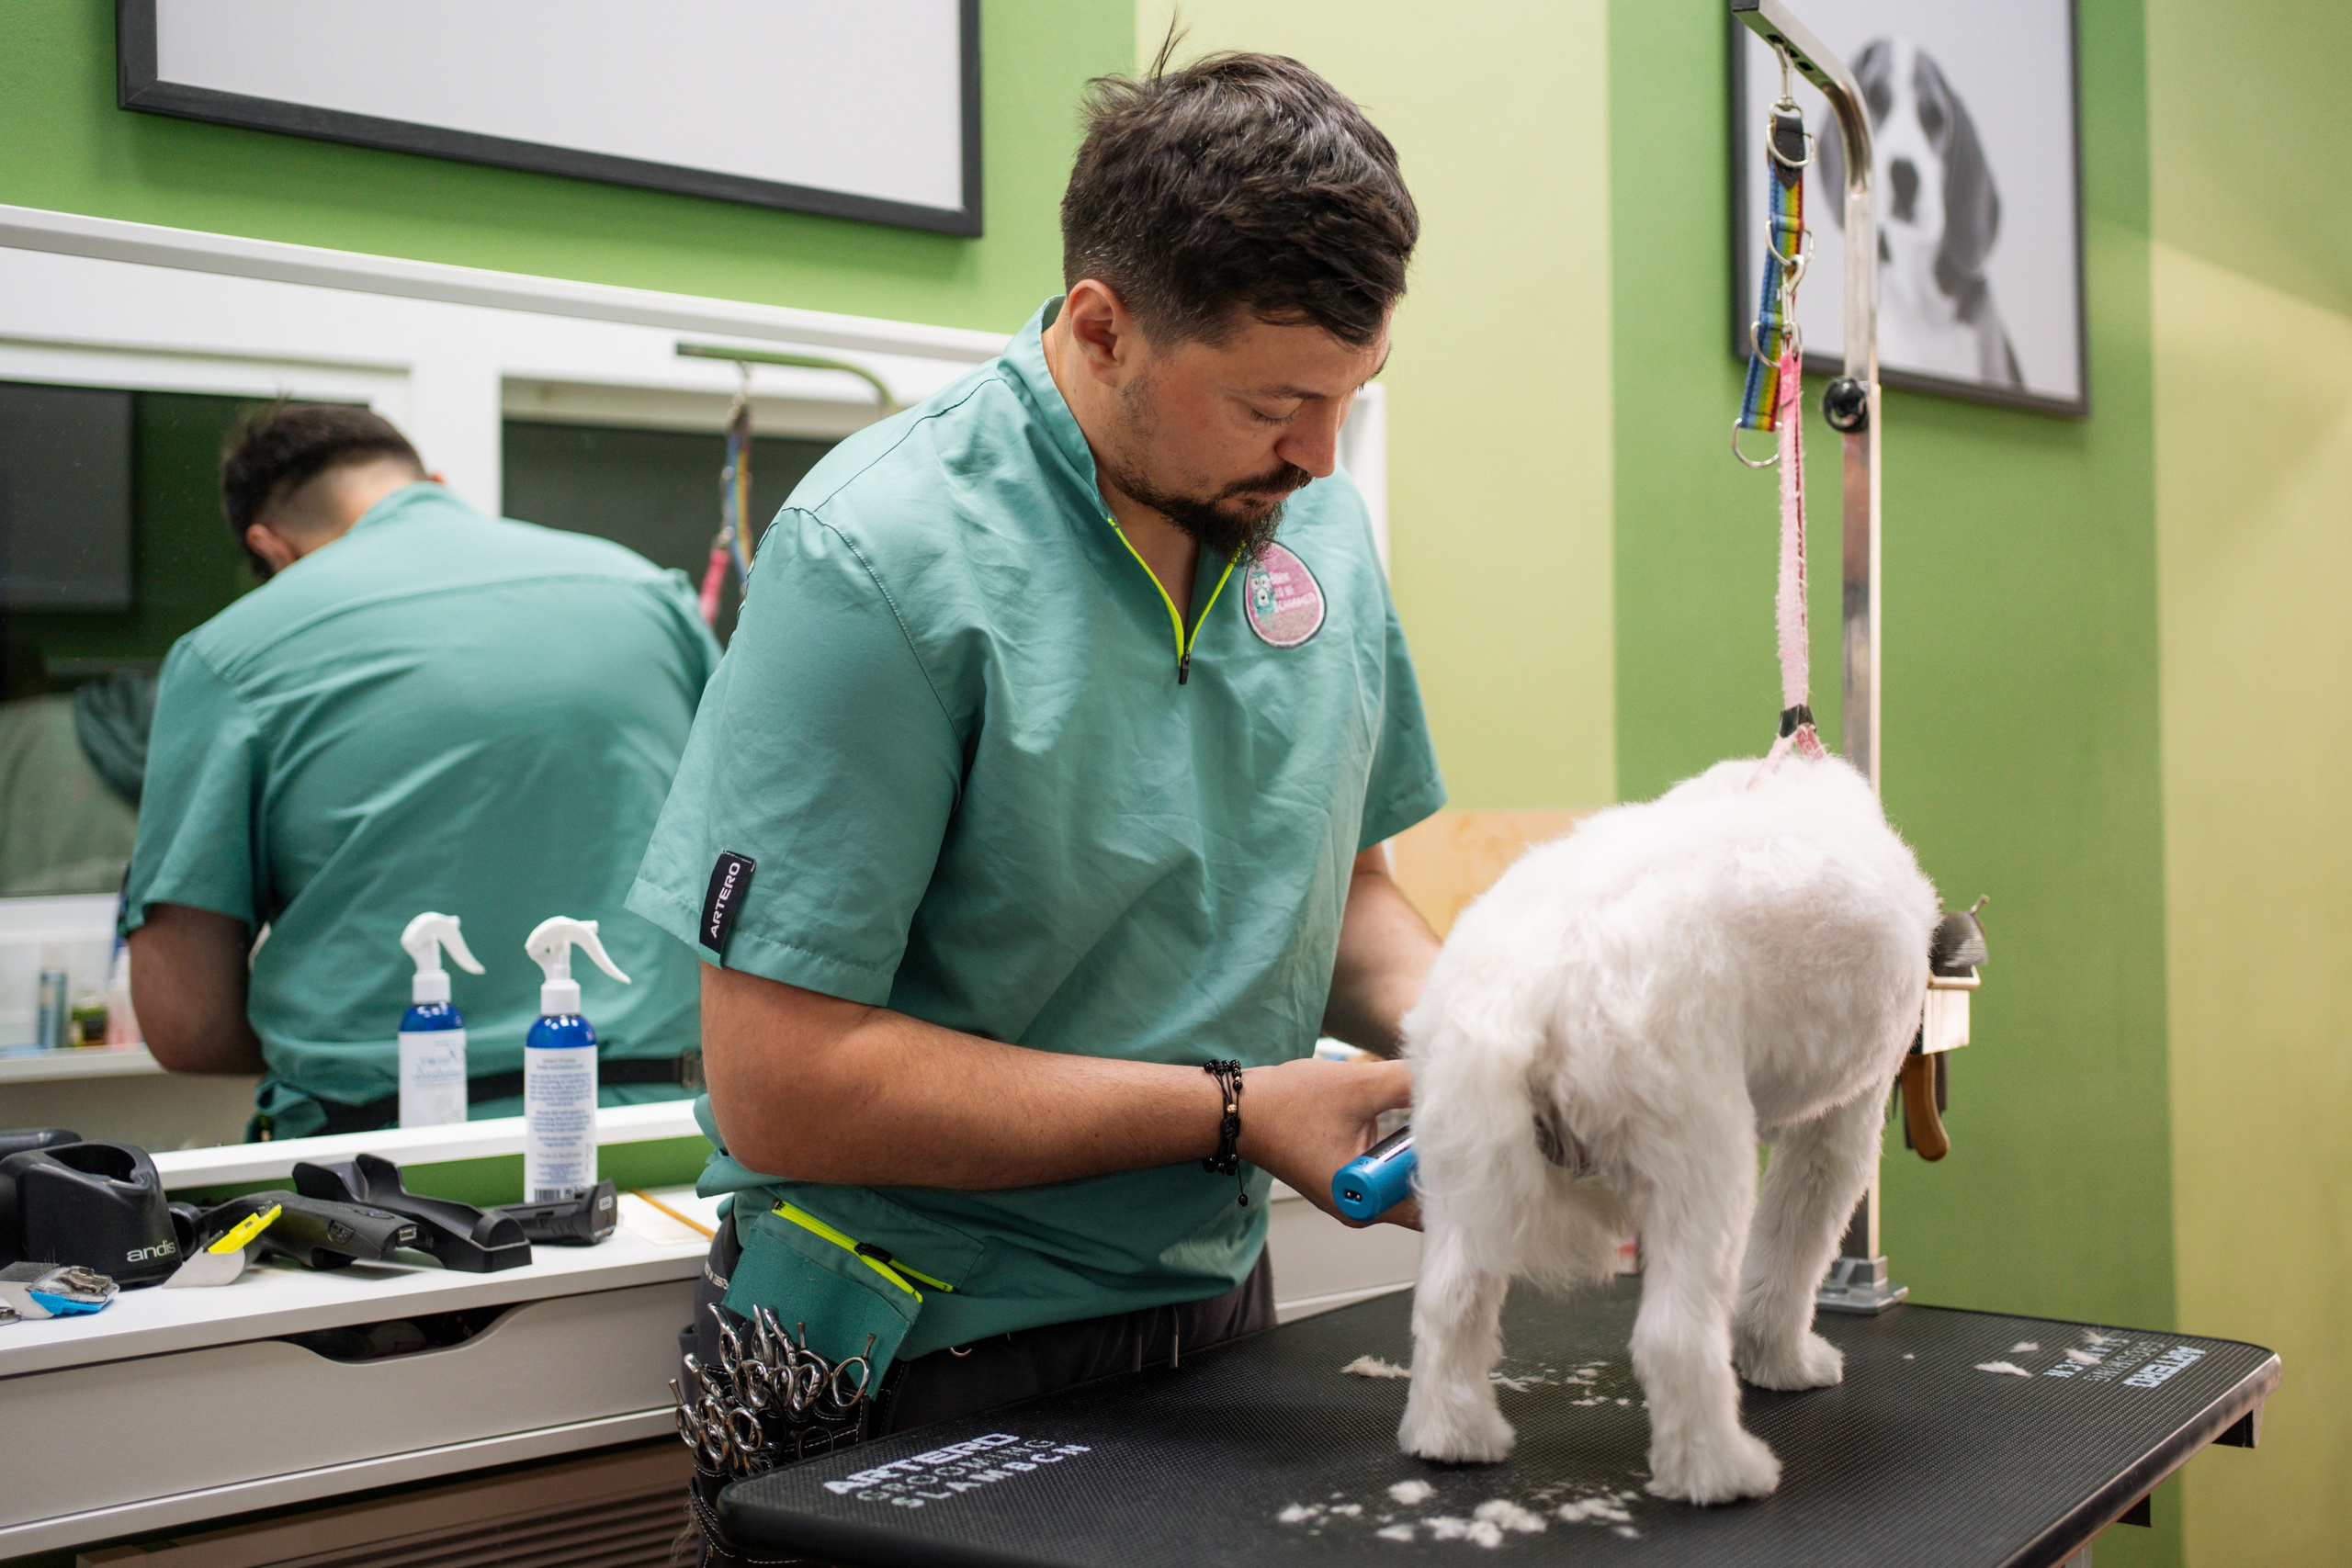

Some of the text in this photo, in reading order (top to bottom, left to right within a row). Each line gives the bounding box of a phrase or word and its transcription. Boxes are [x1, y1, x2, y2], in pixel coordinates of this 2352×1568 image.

[711, 862, 741, 939] ARTERO
[127, 1239, 175, 1262] andis
[2122, 1345, 2207, 1388] ARTERO
[823, 1432, 1020, 1495] ARTERO
